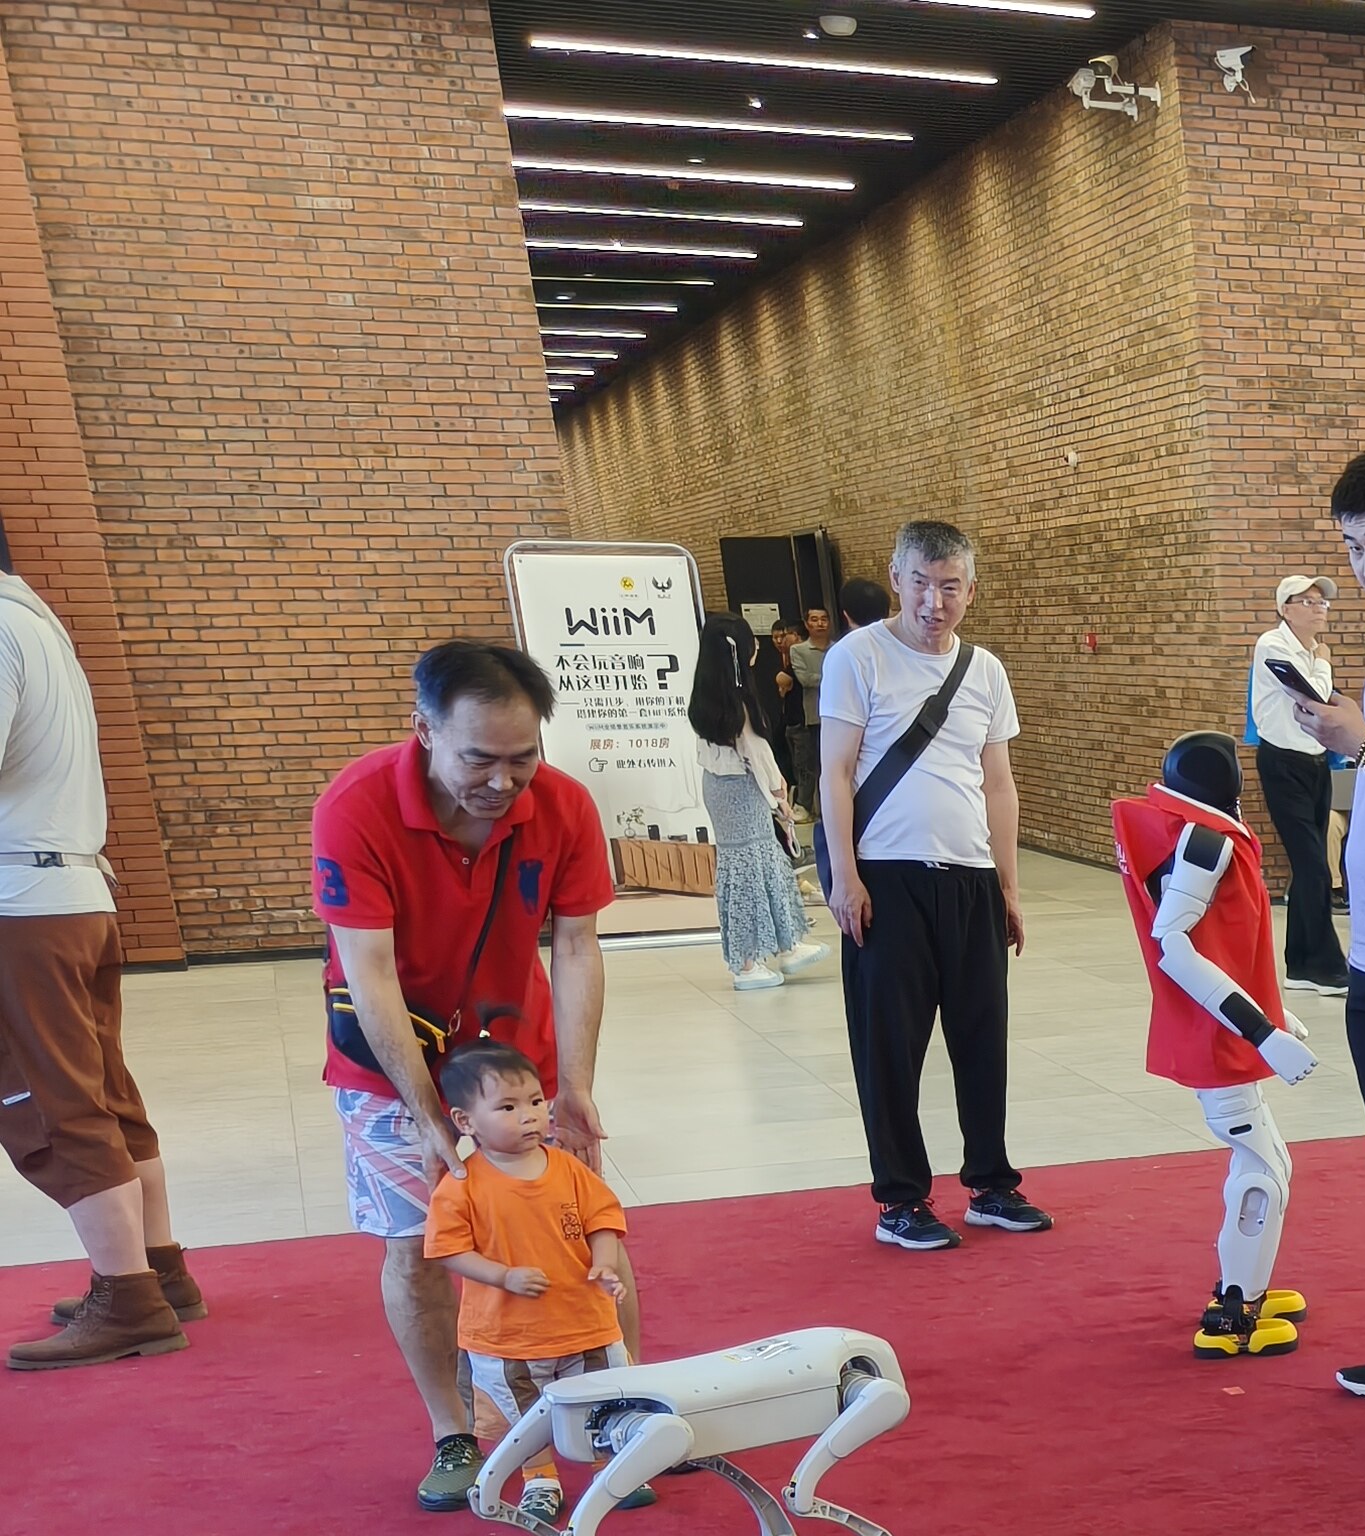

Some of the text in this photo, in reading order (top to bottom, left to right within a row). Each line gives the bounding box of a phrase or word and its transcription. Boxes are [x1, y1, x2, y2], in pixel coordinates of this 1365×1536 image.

[565, 607, 656, 636] WiiM
[554, 654, 645, 671] 不会玩音响
[558, 674, 648, 692] 从这里开始
